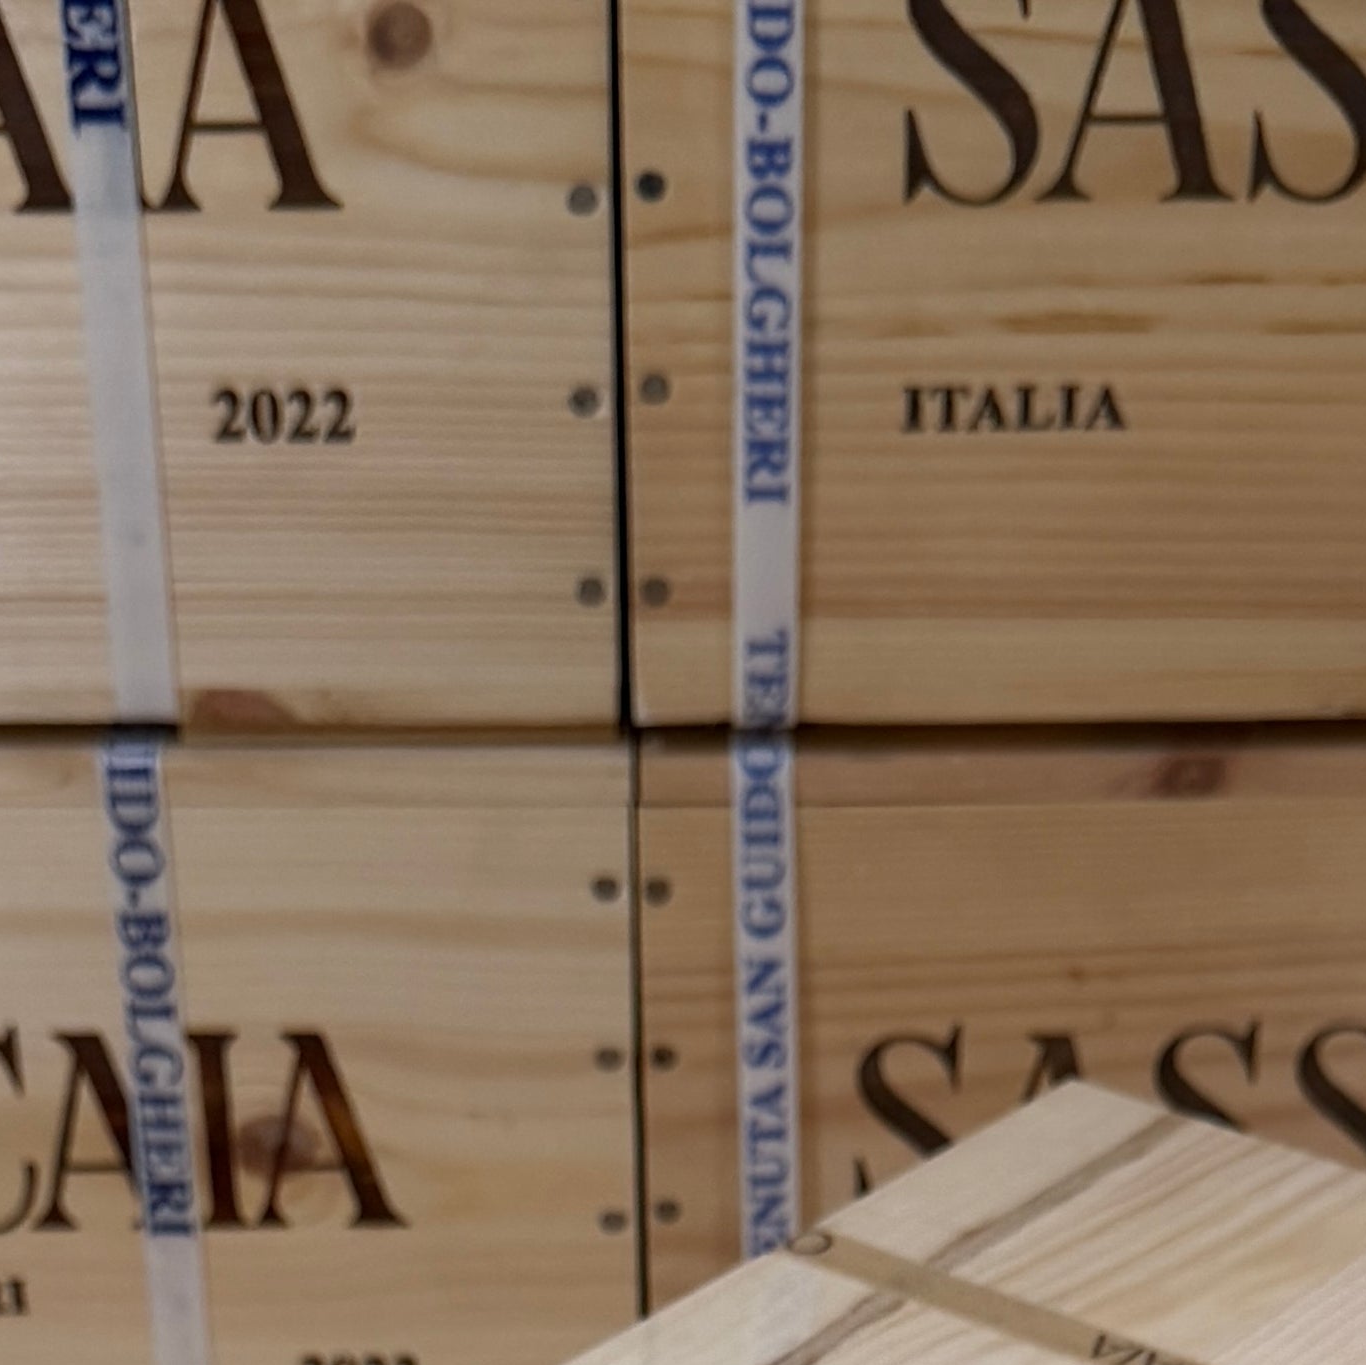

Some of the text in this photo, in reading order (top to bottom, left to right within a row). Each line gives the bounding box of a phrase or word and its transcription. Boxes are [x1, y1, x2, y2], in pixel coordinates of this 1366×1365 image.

[211, 388, 357, 445] 2022
[901, 383, 1128, 434] ITALIA
[103, 738, 197, 1238] IDO-BOLGHERI
[742, 955, 789, 1071] SAN
